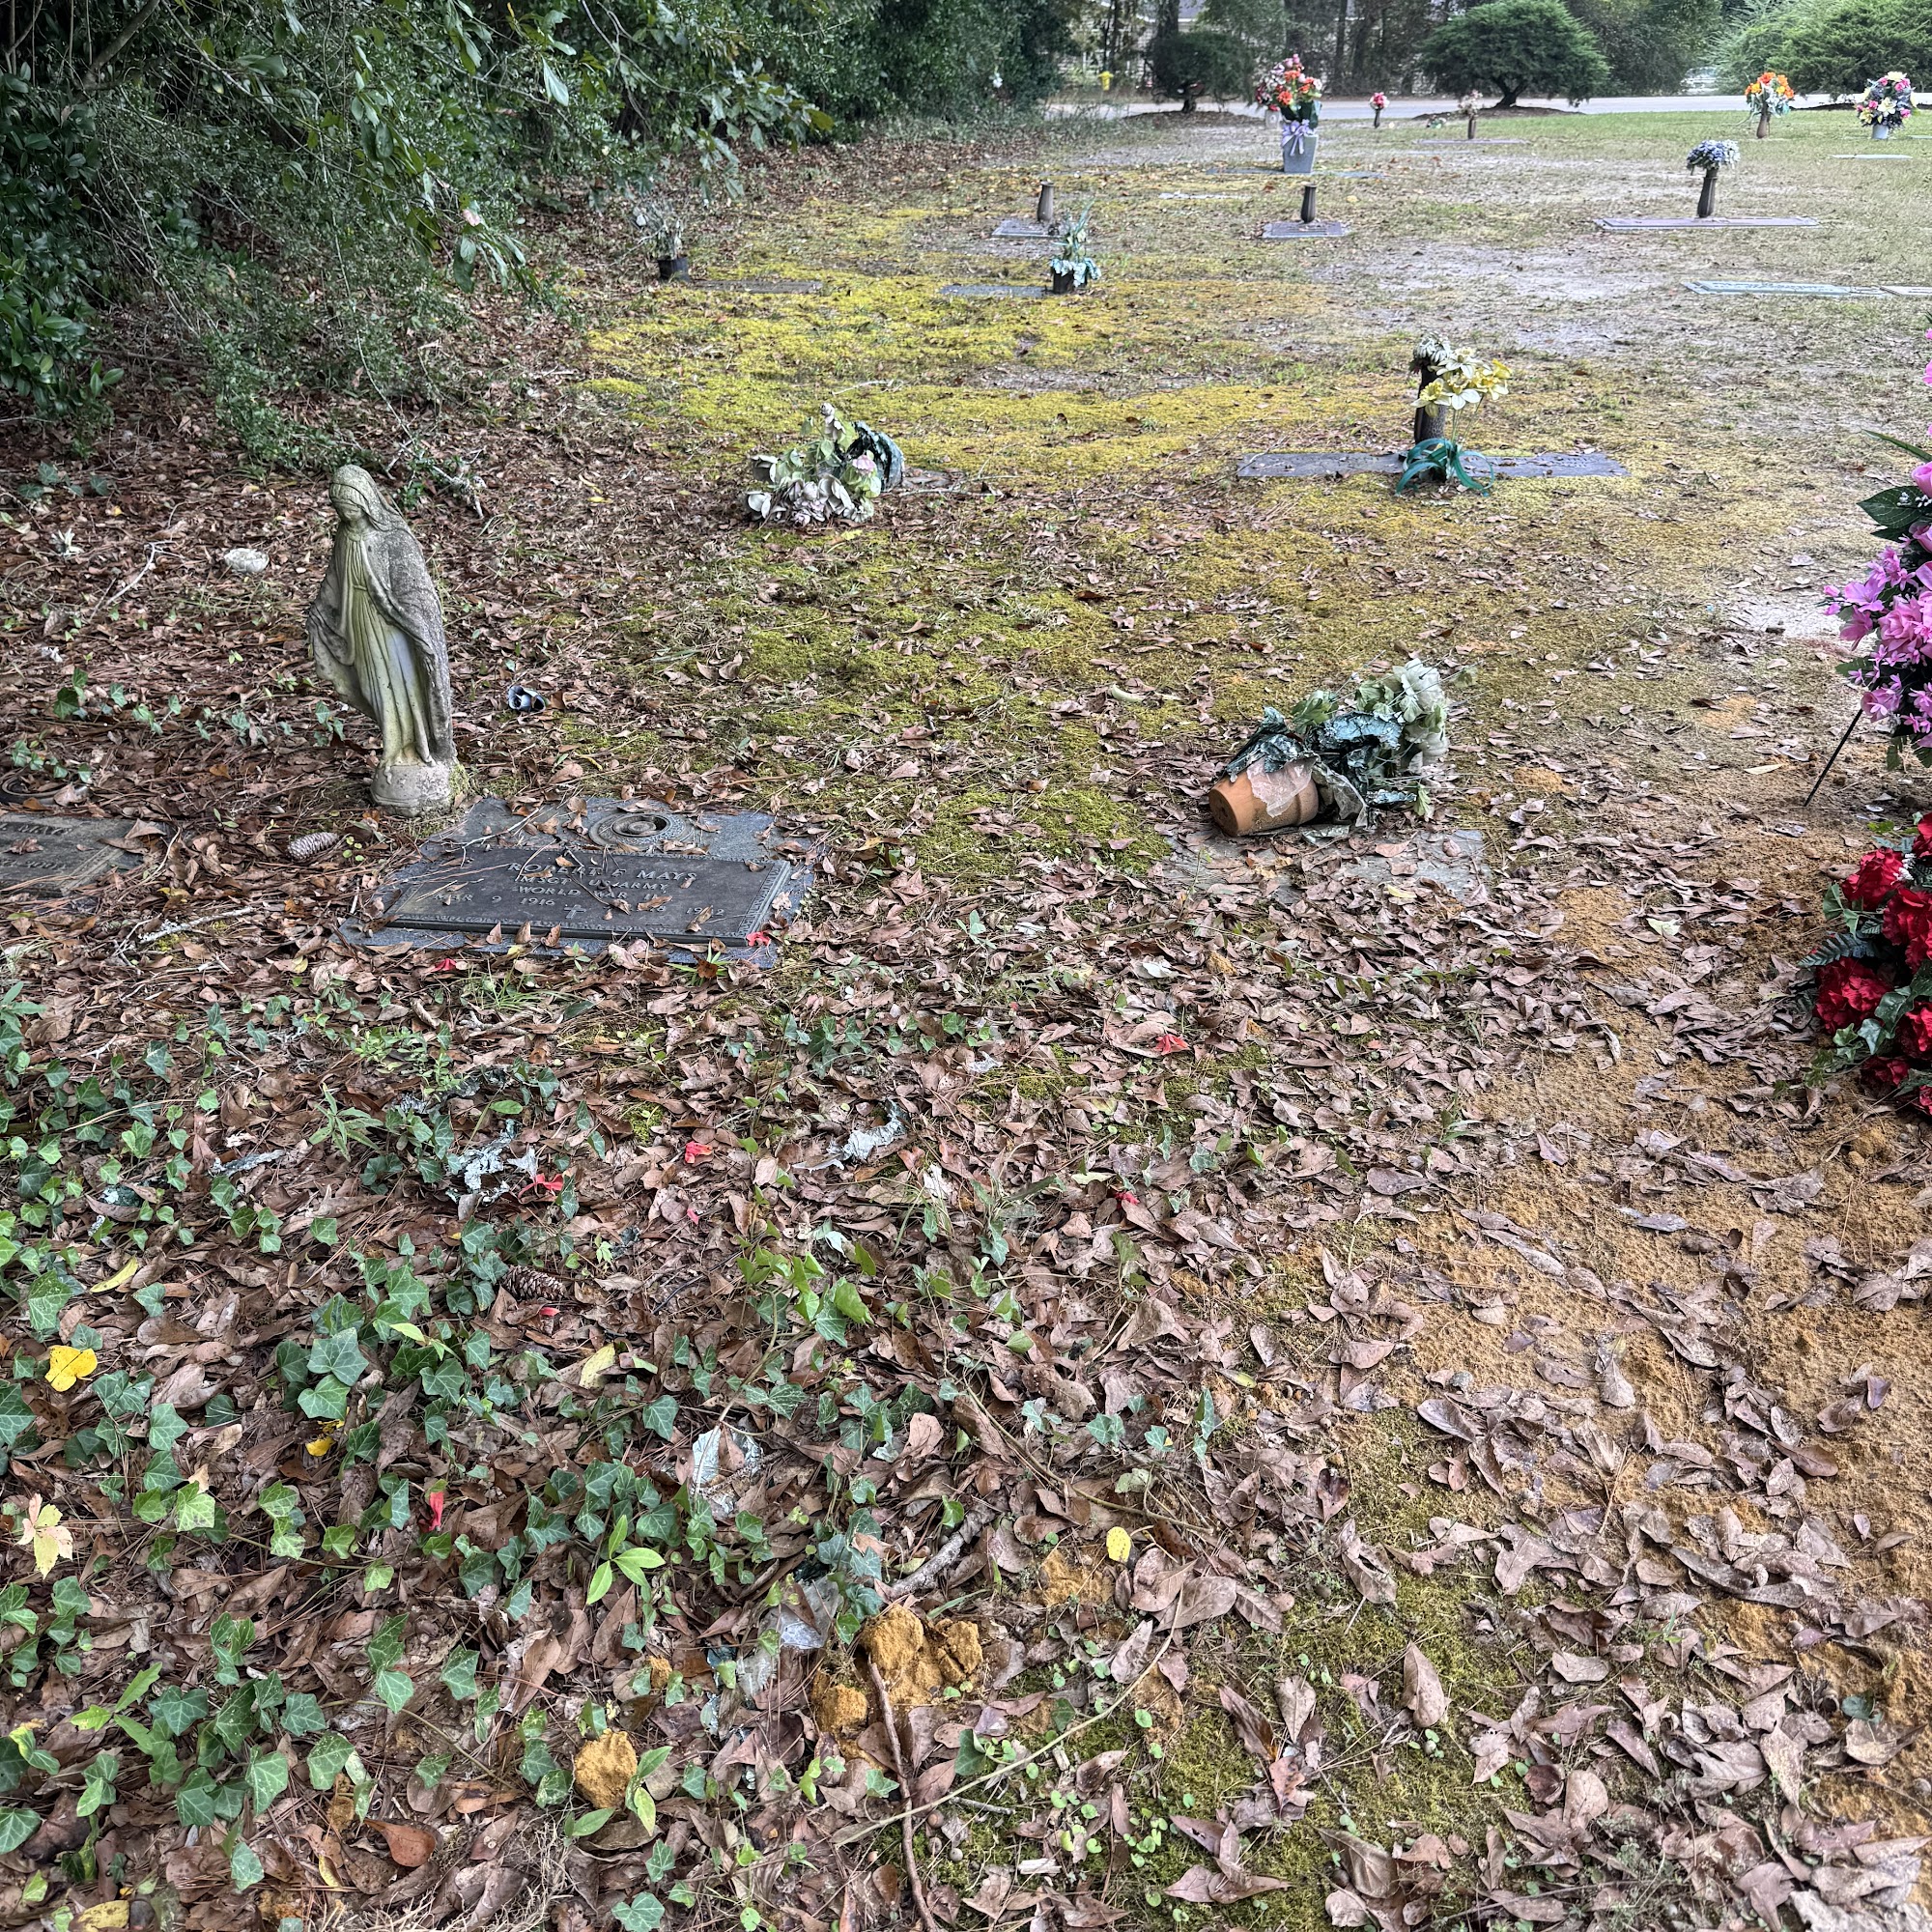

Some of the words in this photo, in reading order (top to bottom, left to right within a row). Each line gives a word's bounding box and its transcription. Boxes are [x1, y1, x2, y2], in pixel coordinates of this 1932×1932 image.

[507, 863, 601, 877] ROBERT
[637, 869, 696, 881] MAYS
[618, 880, 668, 890] ARMY
[519, 886, 582, 896] WORLD
[593, 890, 628, 898] WAR
[492, 895, 502, 904] 9
[520, 897, 555, 906] 1916
[686, 906, 725, 917] 192
